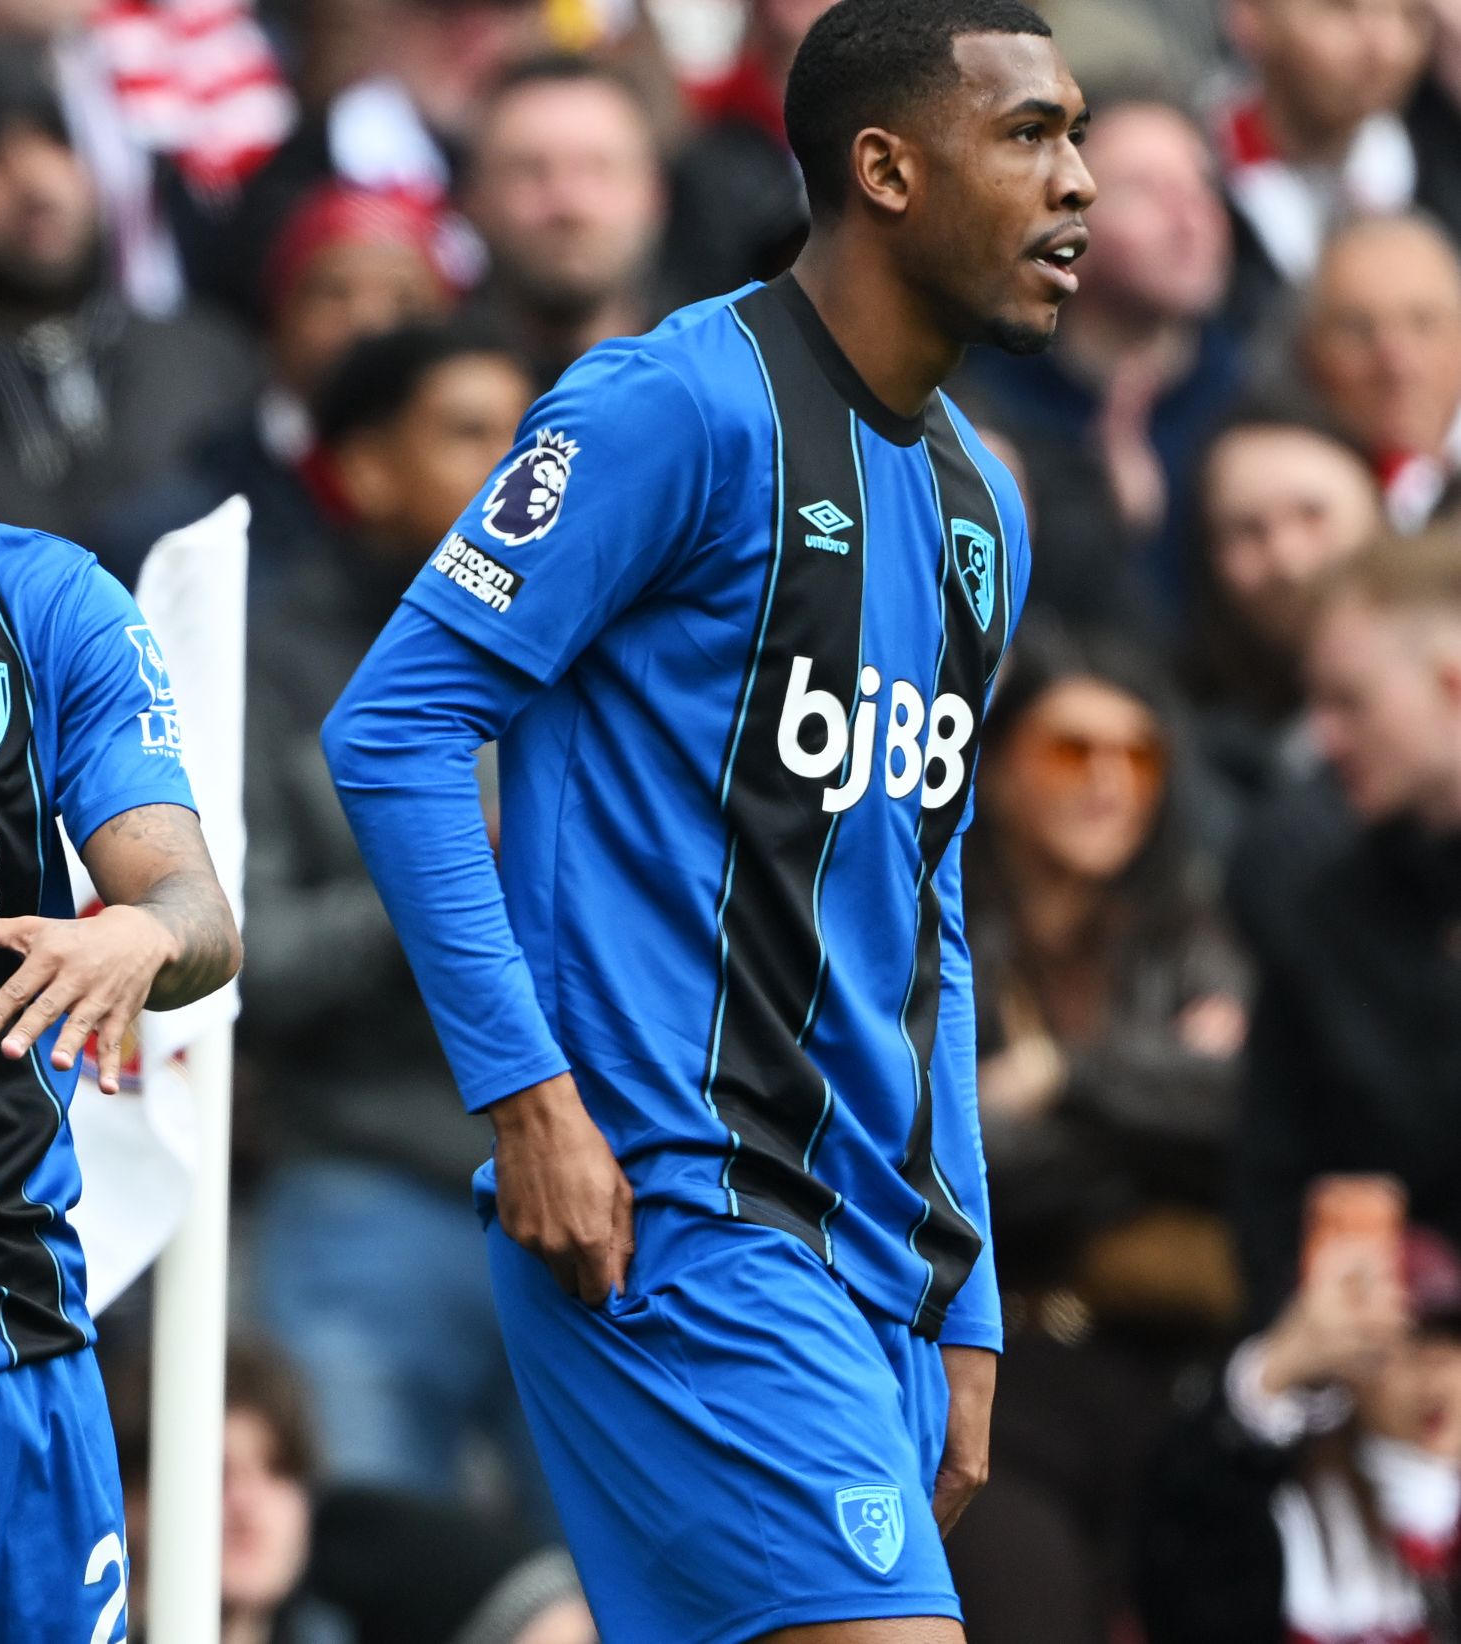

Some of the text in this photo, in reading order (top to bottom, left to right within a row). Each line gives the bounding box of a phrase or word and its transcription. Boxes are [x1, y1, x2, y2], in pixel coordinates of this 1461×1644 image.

[805, 534, 849, 555] umbro
[460, 548, 514, 592] room
[778, 656, 974, 812] bj88
